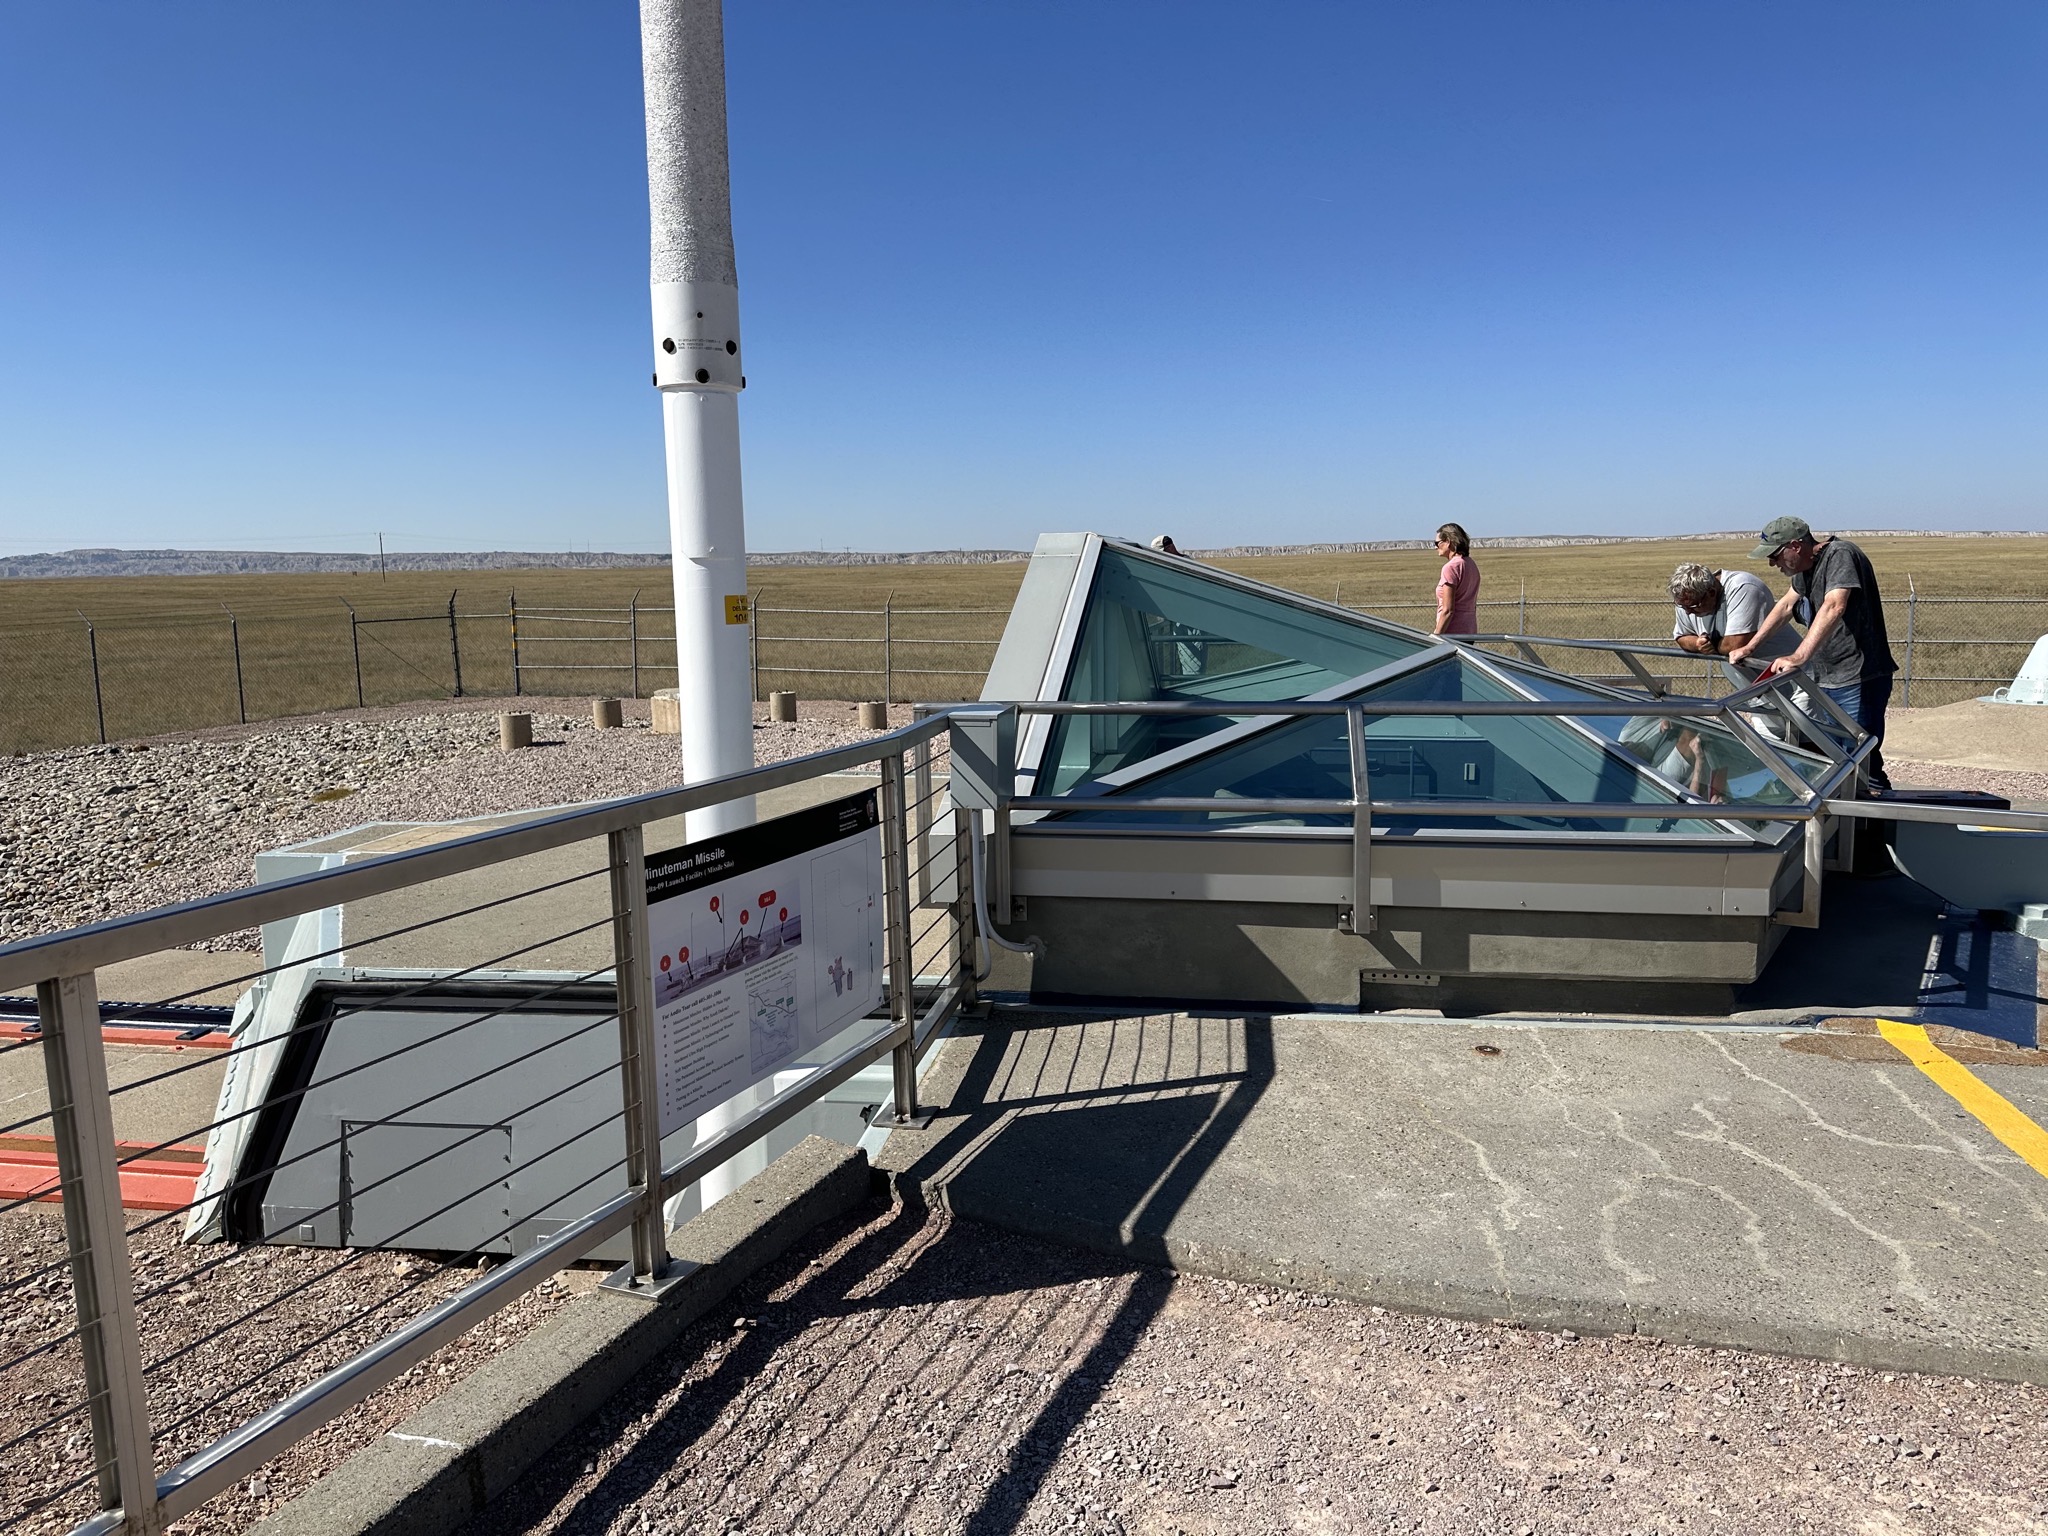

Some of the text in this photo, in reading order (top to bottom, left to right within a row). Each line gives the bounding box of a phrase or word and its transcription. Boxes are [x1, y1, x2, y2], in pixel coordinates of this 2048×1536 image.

[696, 848, 725, 866] Missile
[646, 882, 664, 893] elta-09
[666, 876, 684, 888] Launch
[686, 870, 703, 881] Facility
